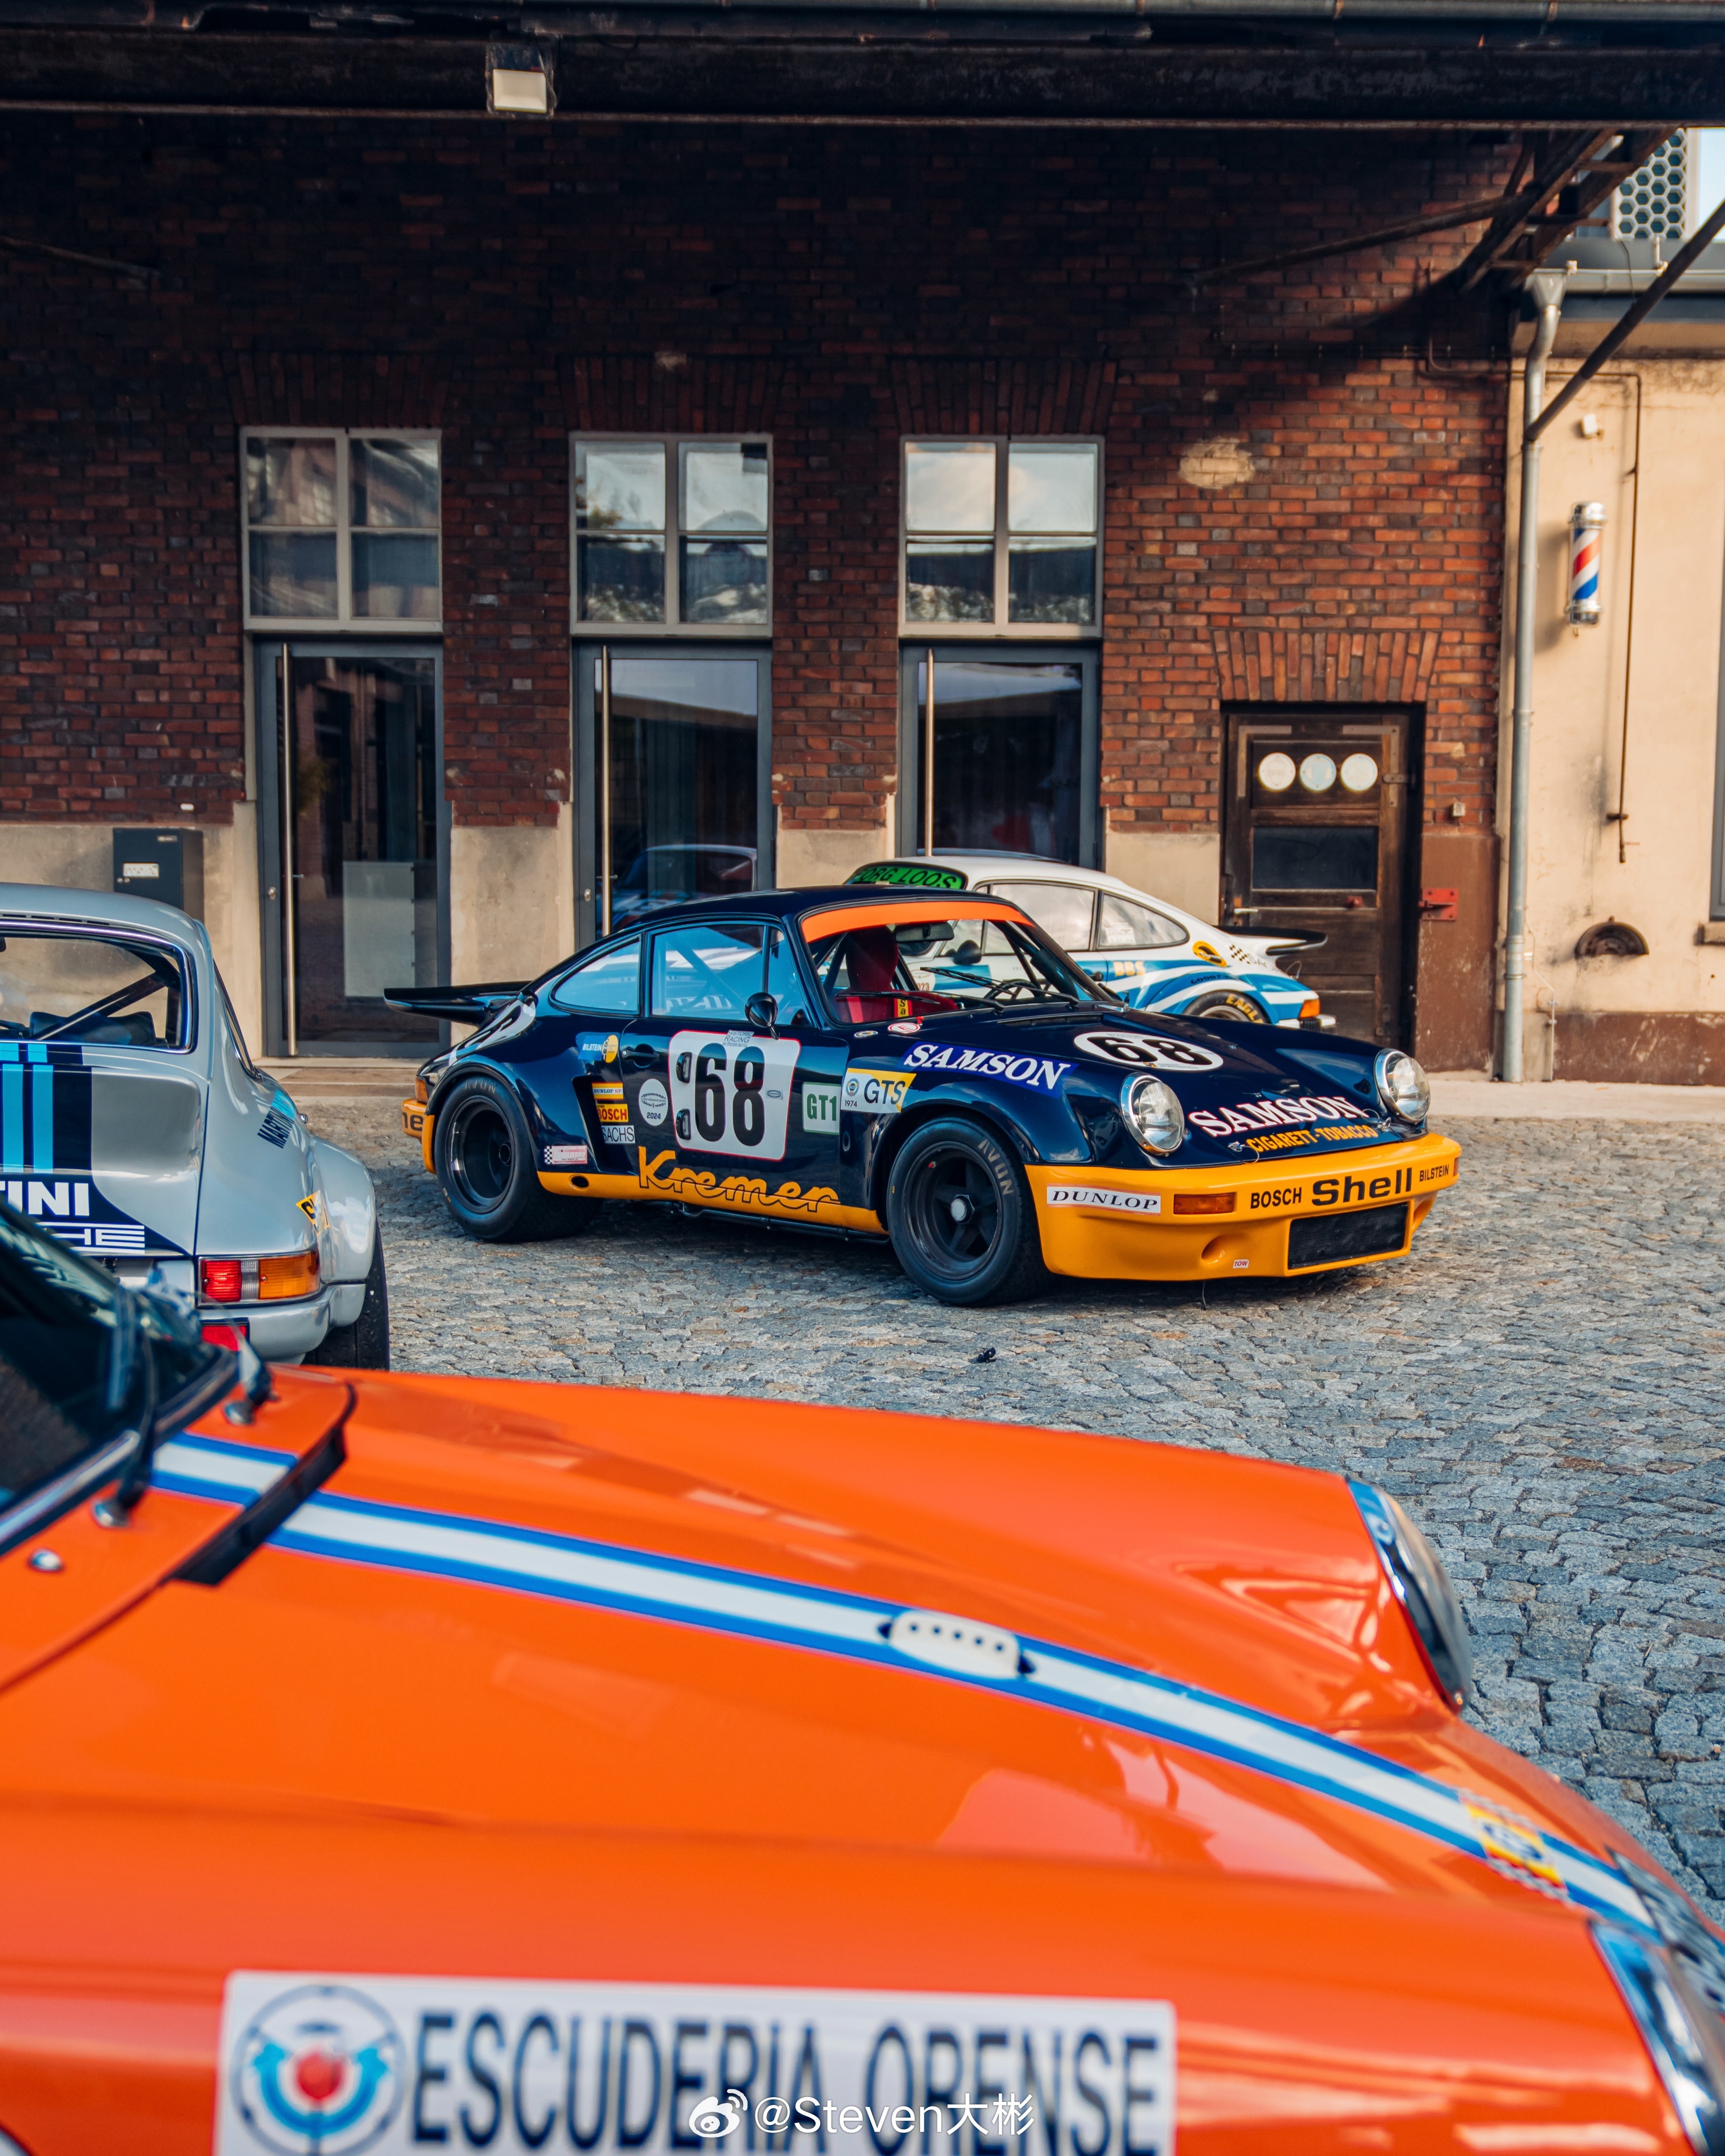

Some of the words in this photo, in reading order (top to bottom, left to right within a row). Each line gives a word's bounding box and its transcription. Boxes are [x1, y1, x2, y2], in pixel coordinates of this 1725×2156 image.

[898, 870, 957, 889] LOOS
[1113, 961, 1146, 976] BBS
[1087, 1036, 1213, 1065] 68
[903, 1044, 1071, 1090] SAMSON
[695, 1043, 765, 1146] 68
[864, 1079, 905, 1105] GTS
[807, 1094, 837, 1121] GT1
[1189, 1096, 1370, 1137] SAMSON
[257, 1106, 295, 1149] MARTINI
[603, 1127, 634, 1142] SACHS
[638, 1146, 841, 1213] Kremer
[1419, 1164, 1449, 1182] BILSTEIN
[1051, 1191, 1158, 1210] DUNLOP
[1250, 1187, 1302, 1210] BOSCH
[1311, 1167, 1412, 1206] Shell
